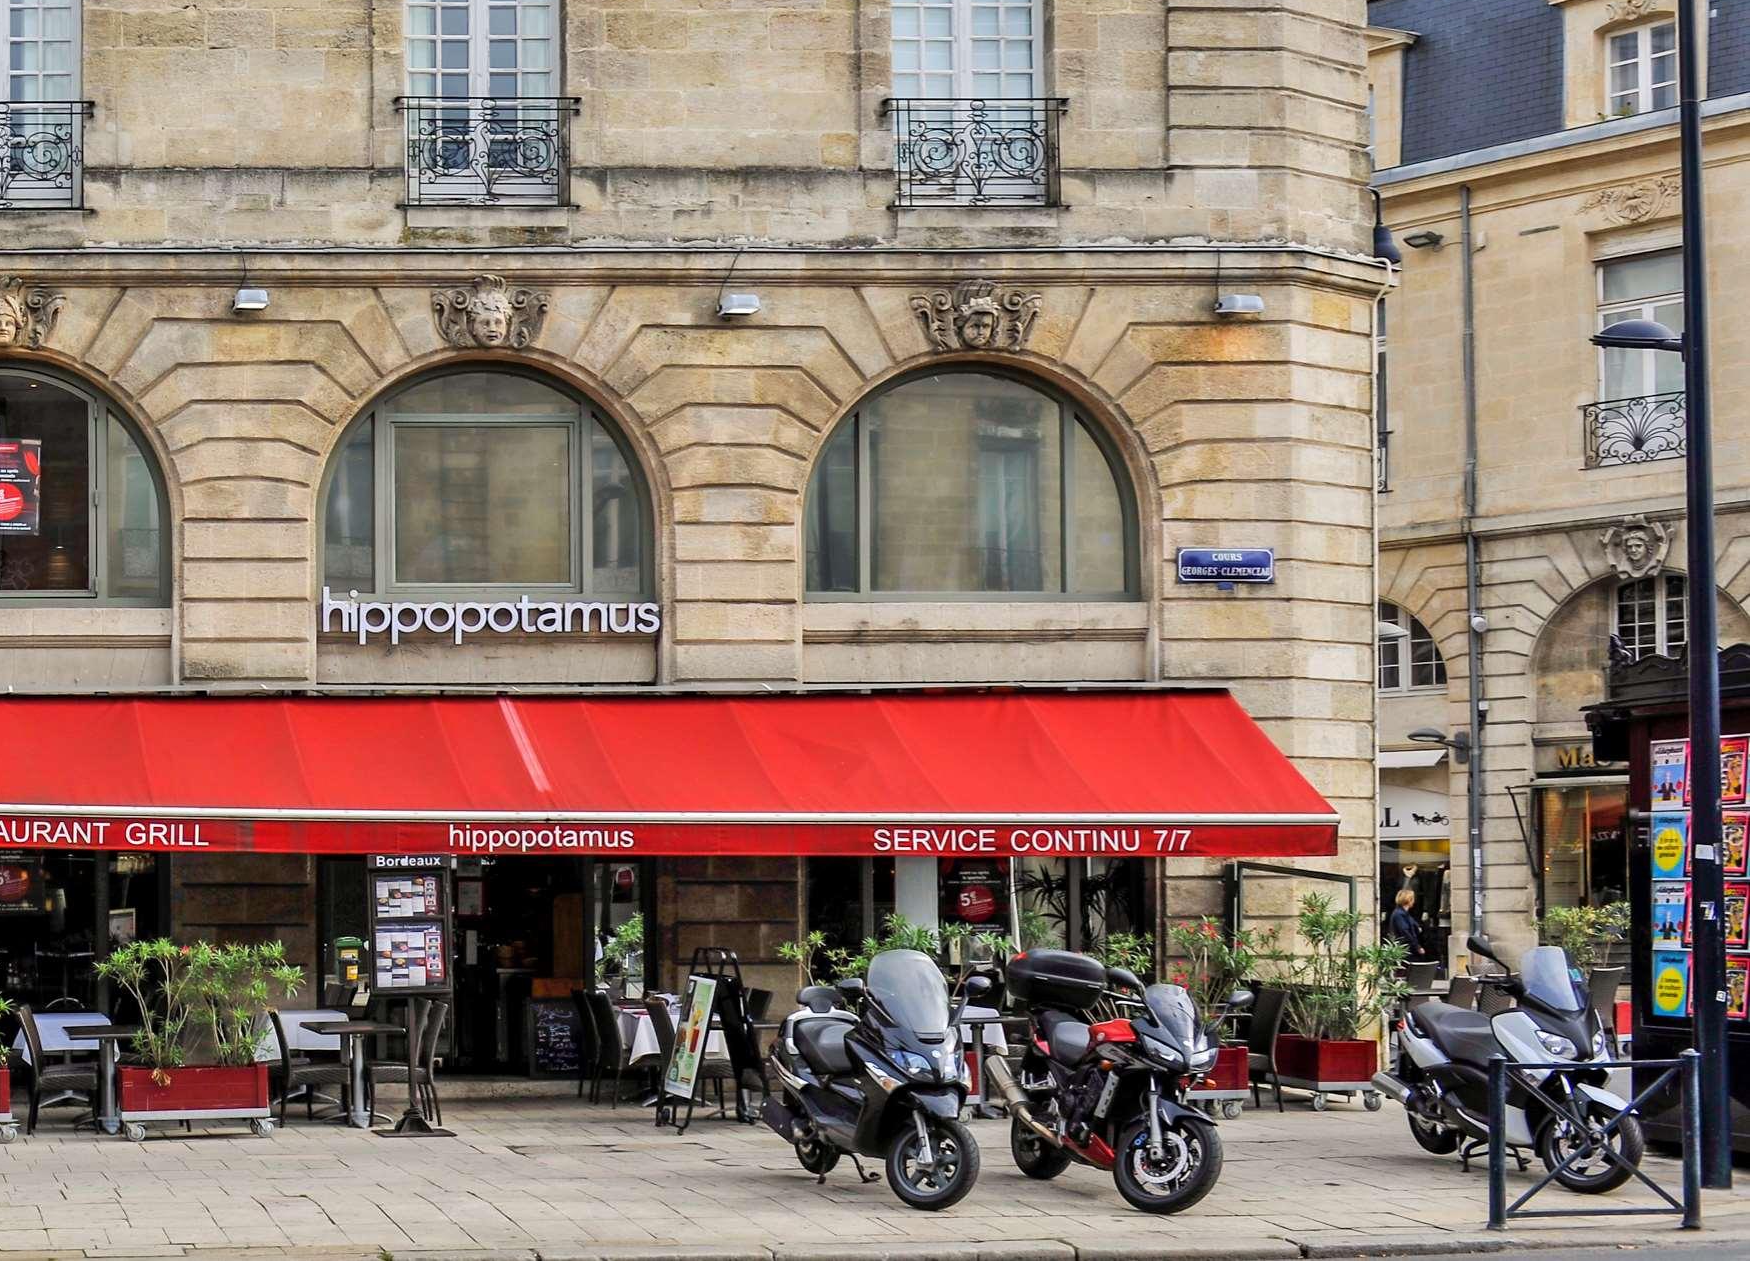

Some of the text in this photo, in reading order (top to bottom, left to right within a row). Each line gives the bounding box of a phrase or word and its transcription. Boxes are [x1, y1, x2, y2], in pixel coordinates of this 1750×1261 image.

[1212, 553, 1242, 562] COURS
[322, 586, 661, 645] hippopotamus
[125, 821, 210, 846] GRILL
[449, 824, 635, 852] hippopotamus
[873, 828, 1193, 852] SERVICE CONTINU 7/7
[376, 856, 442, 867] Bordeaux
